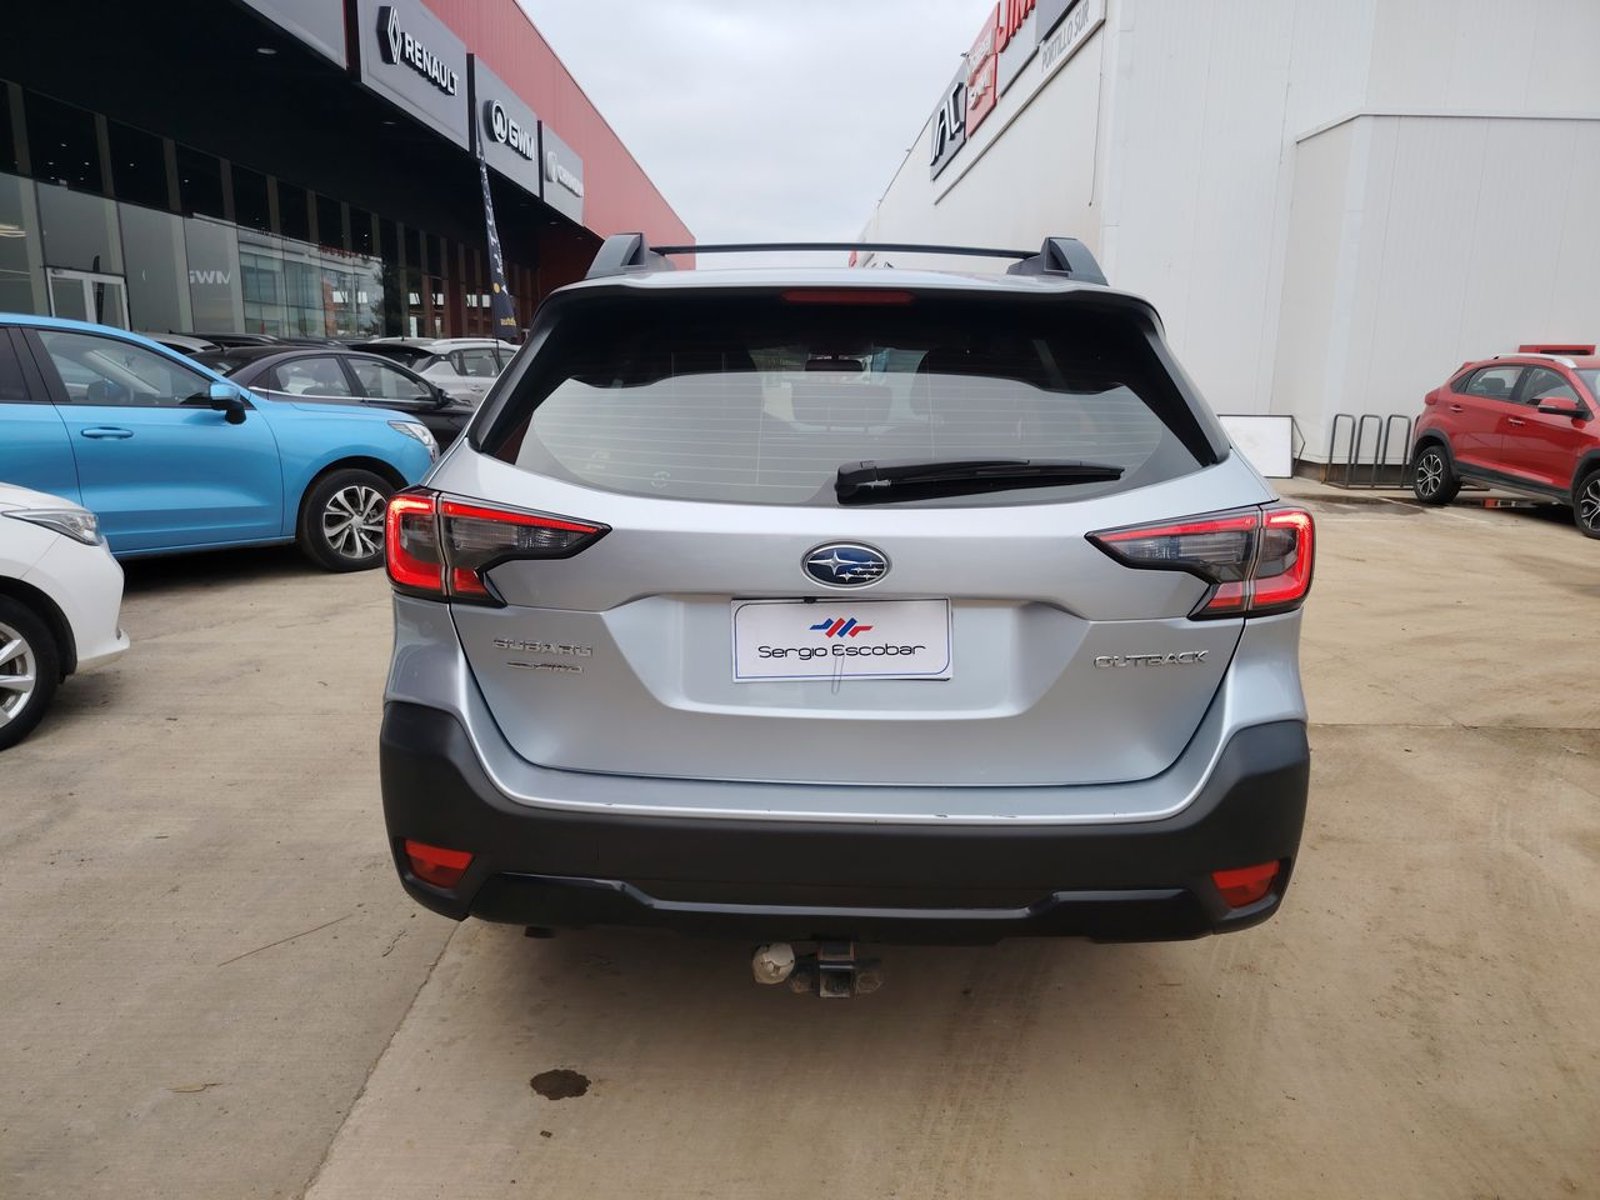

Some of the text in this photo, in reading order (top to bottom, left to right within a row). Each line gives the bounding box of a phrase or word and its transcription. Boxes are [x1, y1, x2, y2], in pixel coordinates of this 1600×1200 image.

[404, 32, 459, 96] RENAULT
[508, 119, 534, 160] GWM
[493, 639, 593, 656] SUBARU
[758, 643, 926, 660] Sergio Escobar
[1094, 650, 1209, 668] OUTBACK
